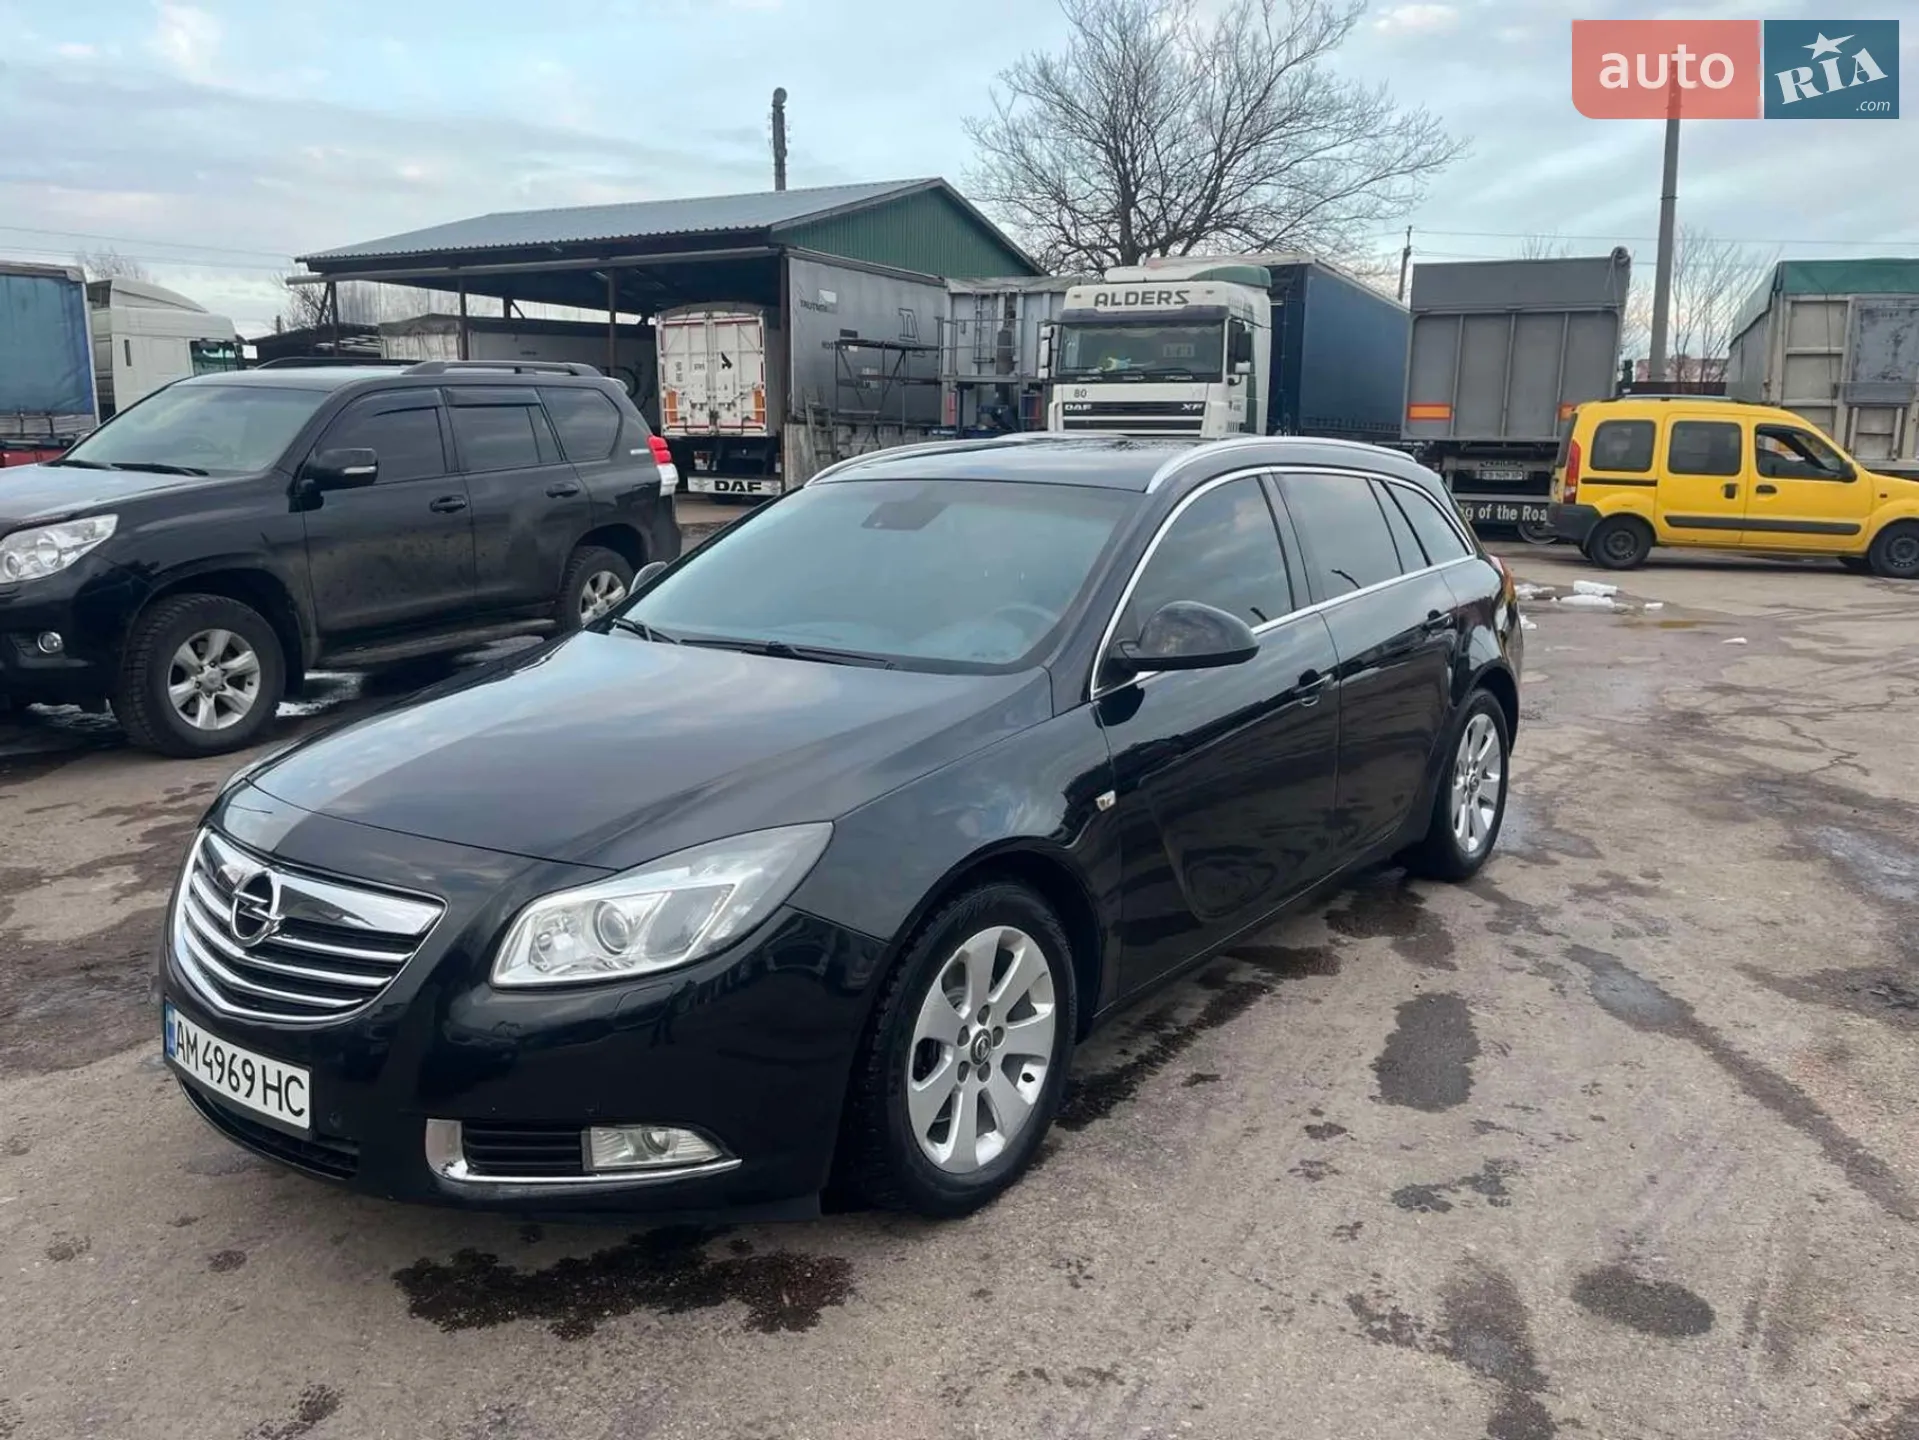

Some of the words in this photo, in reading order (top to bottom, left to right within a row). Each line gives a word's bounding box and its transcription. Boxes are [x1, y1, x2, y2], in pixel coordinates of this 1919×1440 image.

[1094, 290, 1190, 307] ALDERS
[1074, 389, 1087, 398] 80
[1064, 403, 1092, 411] DAF
[1181, 403, 1204, 411] XF
[715, 480, 762, 493] DAF
[1478, 504, 1492, 519] of
[1497, 505, 1518, 520] the
[1522, 505, 1547, 521] Roa
[176, 1021, 199, 1071] AM
[202, 1040, 256, 1099] 4969
[261, 1065, 305, 1118] HC
